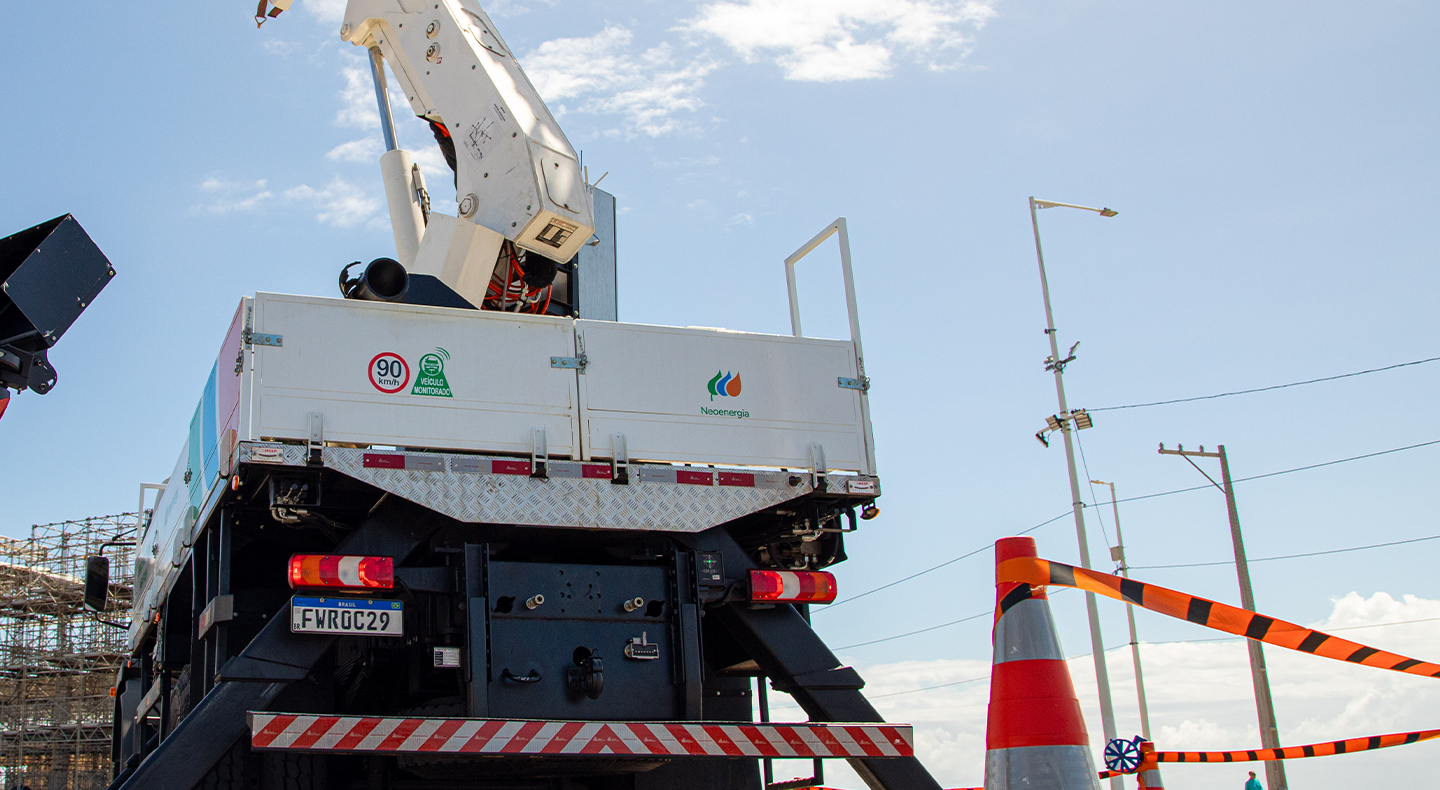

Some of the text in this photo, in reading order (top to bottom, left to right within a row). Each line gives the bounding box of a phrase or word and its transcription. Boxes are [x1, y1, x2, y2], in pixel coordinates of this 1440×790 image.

[377, 359, 401, 378] 90
[379, 377, 399, 386] km/h
[420, 377, 443, 386] VEÍCULO
[414, 387, 450, 395] MONITORADO
[701, 407, 749, 419] Neoenergia
